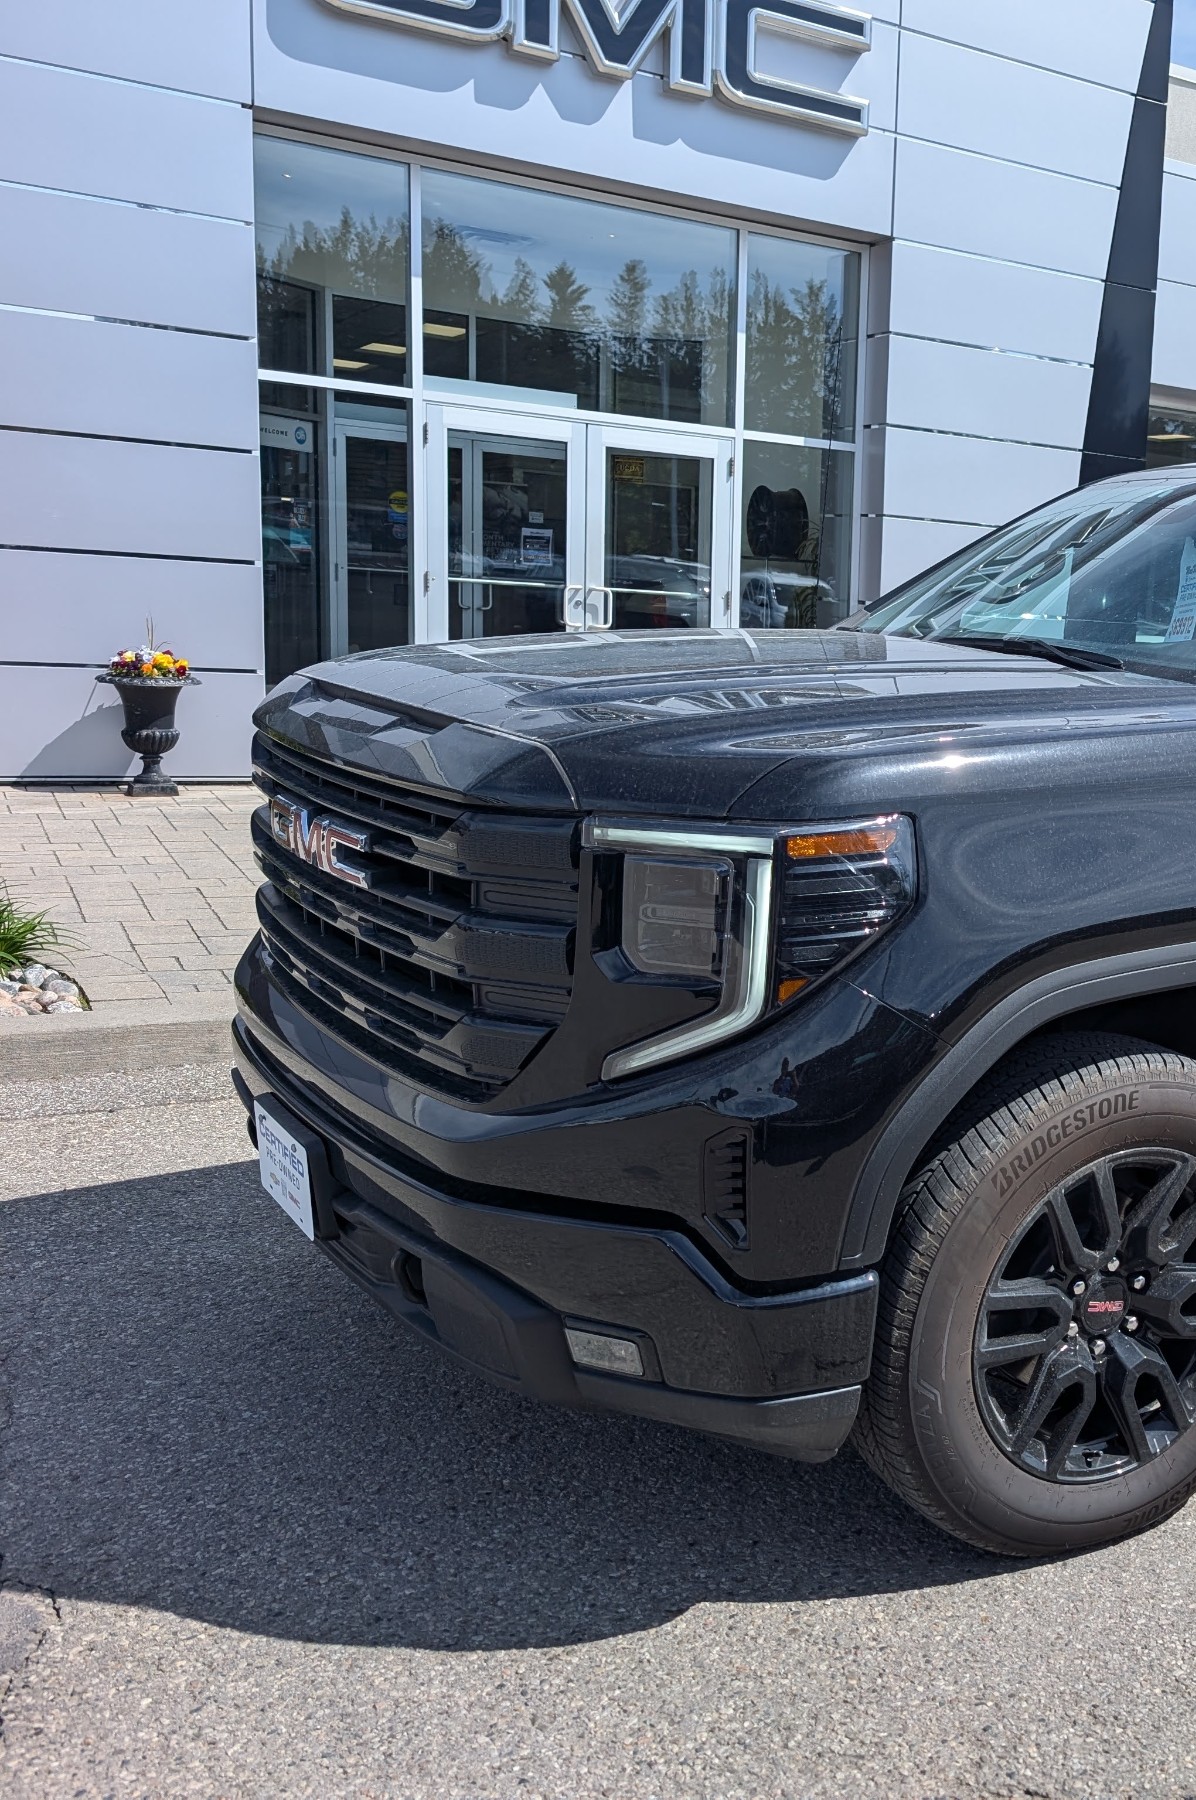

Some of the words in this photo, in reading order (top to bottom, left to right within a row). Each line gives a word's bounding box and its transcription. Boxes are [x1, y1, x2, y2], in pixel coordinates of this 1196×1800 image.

[310, 0, 871, 136] MC
[271, 795, 368, 890] GMC
[259, 1120, 305, 1178] CERTIFIED
[265, 1145, 301, 1191] PRE-OWNED
[990, 1089, 1140, 1199] BRIDGESTONE
[1087, 1300, 1124, 1312] GMC
